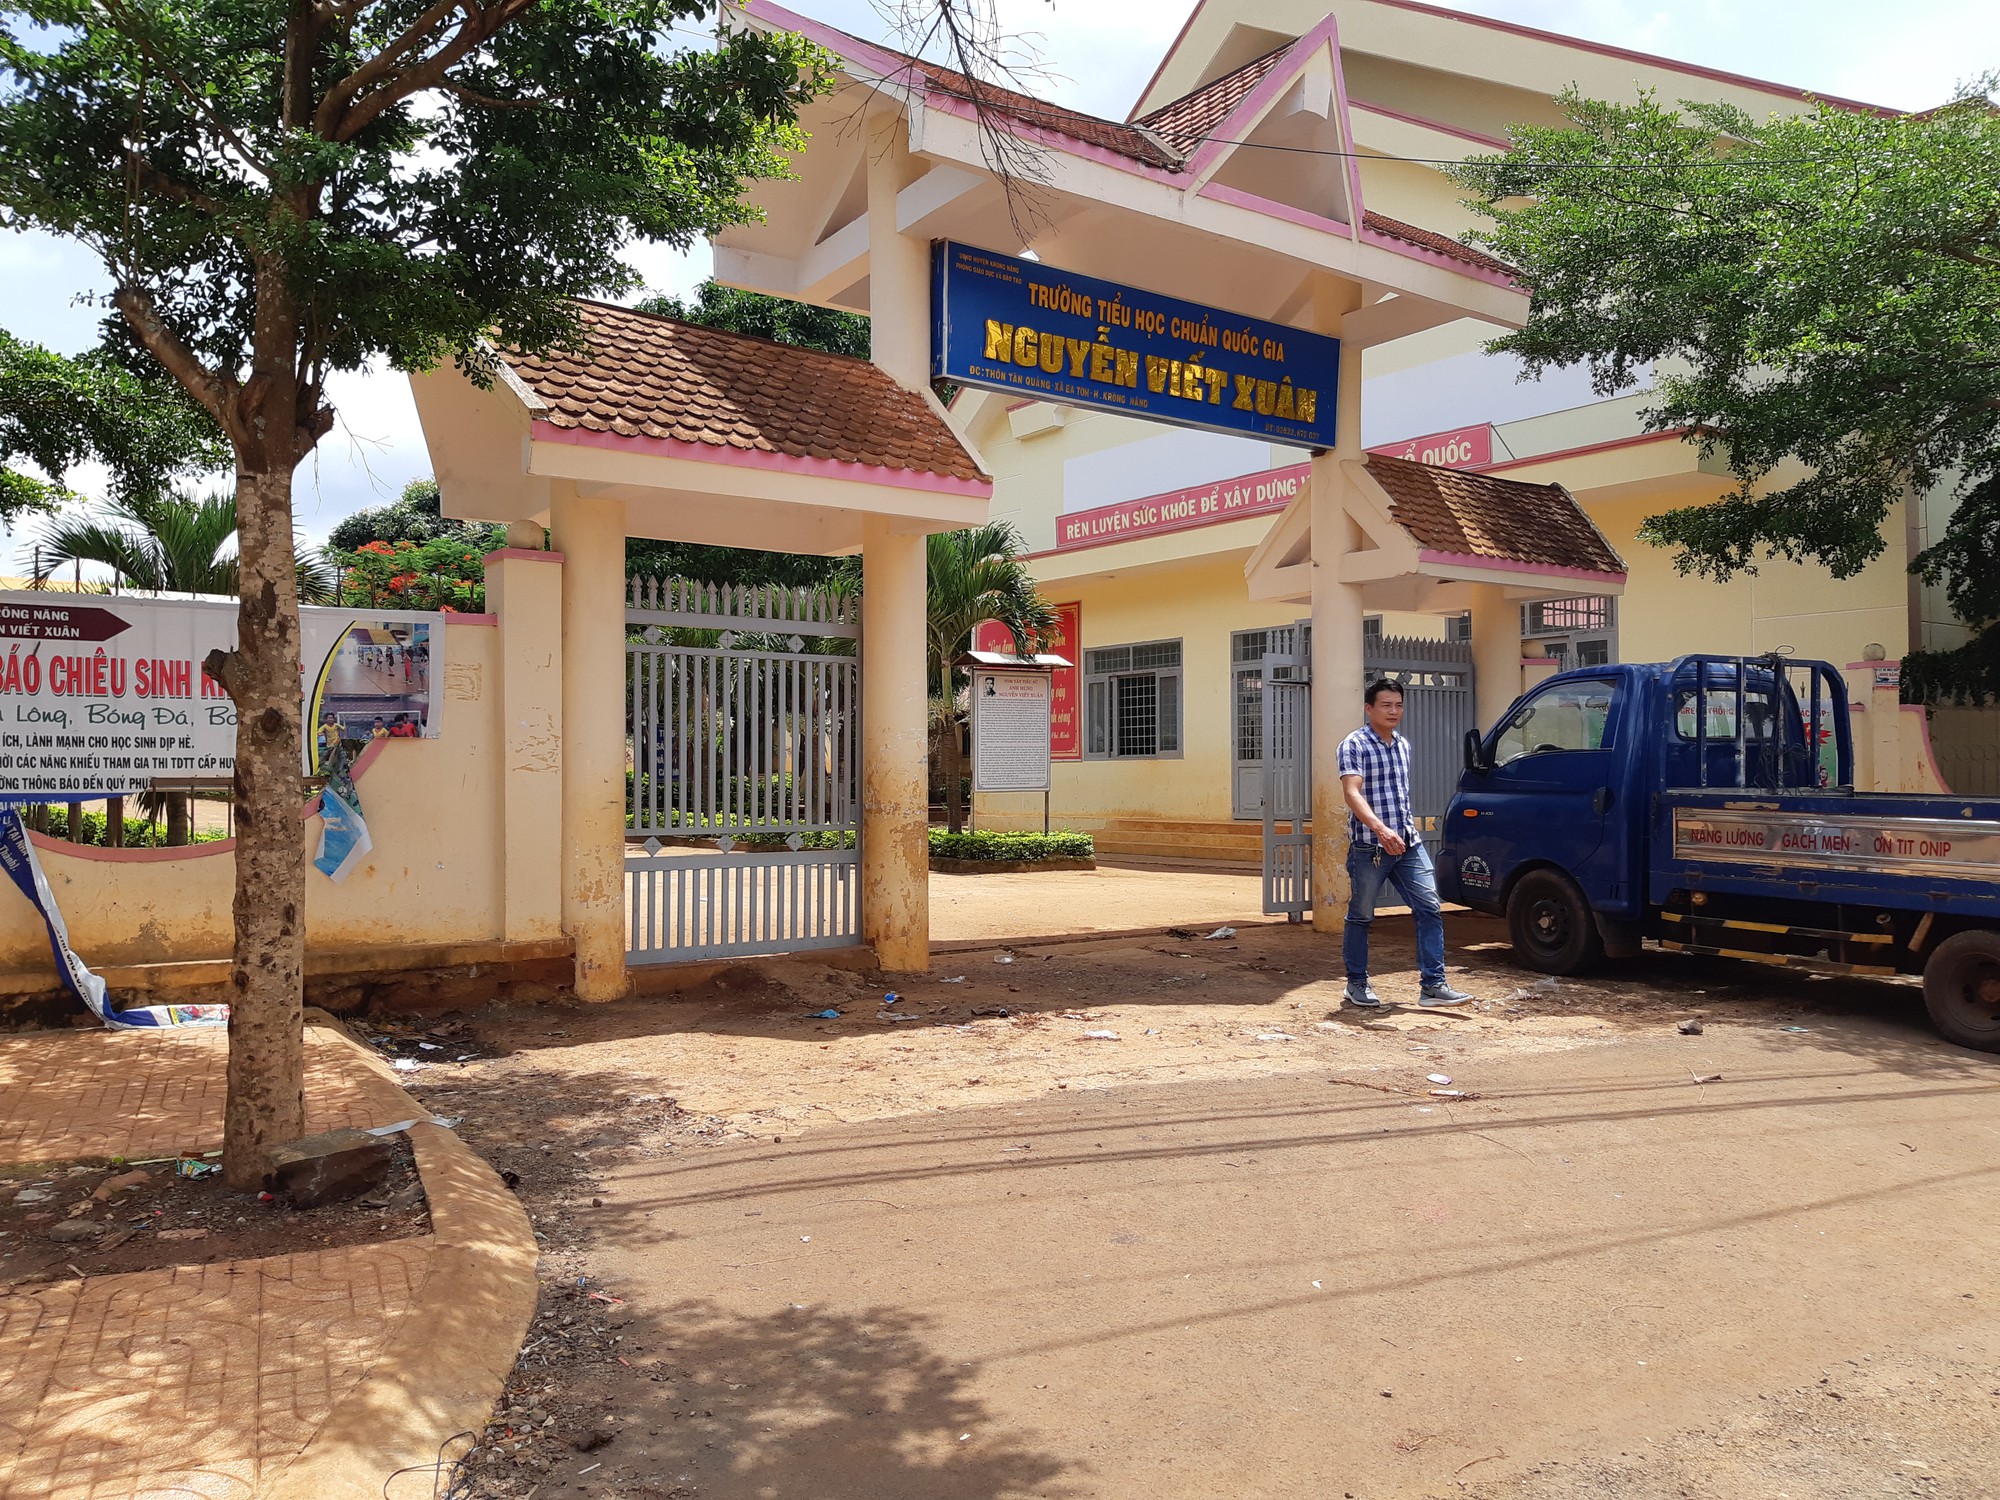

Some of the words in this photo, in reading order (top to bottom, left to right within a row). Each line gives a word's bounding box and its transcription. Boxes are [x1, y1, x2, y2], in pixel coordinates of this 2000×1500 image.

[1028, 282, 1092, 318] TRƯỜNG
[1098, 291, 1131, 328] TIỂU
[1135, 308, 1165, 339] HỌC
[1170, 313, 1218, 347] CHUẨN
[1222, 326, 1259, 357] QUỐC
[1263, 338, 1285, 363] GIA
[983, 318, 1139, 389] NGUYỄN
[1145, 351, 1228, 406] VIẾT
[1232, 374, 1318, 424] XUÂN
[1065, 384, 1075, 394] EA
[1422, 436, 1472, 467] QUỐC
[1067, 519, 1090, 540] RÈN
[1092, 510, 1130, 534] LUYỆN
[1133, 503, 1157, 527] SỨC
[1161, 495, 1197, 521] KHỎE
[1200, 485, 1220, 514] ĐỂ
[1224, 486, 1251, 509] XÂY
[1256, 478, 1297, 503] DỰNG
[0, 606, 30, 620] ÔNG
[33, 609, 70, 622] NĂNG
[10, 622, 40, 636] VIẾT
[44, 625, 80, 638] XUÂN
[0, 643, 42, 696] ÁO
[49, 646, 127, 699] CHIÊU
[134, 658, 192, 700] SINH
[16, 704, 73, 730] Lông,
[84, 703, 146, 731] Bóng
[151, 707, 194, 728] Đá,
[2, 732, 23, 749] ÍCH,
[26, 731, 53, 748] LÀNH
[56, 735, 85, 750] MẠNH
[88, 736, 108, 748] CHO
[111, 736, 131, 750] HỌC
[134, 737, 156, 749] SINH
[160, 737, 176, 752] DỊP
[178, 734, 195, 749] HÈ.
[0, 753, 13, 768] ỜI
[16, 753, 37, 769] CÁC
[40, 754, 67, 769] NĂNG
[70, 752, 100, 769] KHIẾU
[103, 757, 131, 769] THAM
[134, 757, 150, 769] GIA
[152, 757, 168, 769] THI
[171, 757, 195, 769] TDTT
[198, 752, 217, 769] CẤP
[22, 774, 57, 790] THÔNG
[60, 774, 80, 790] BÁO
[83, 773, 103, 790] ĐẾN
[106, 774, 126, 791] QUÝ
[1821, 836, 1850, 851] MEN
[1897, 838, 1914, 855] TIT
[1919, 840, 1951, 857] ONIP
